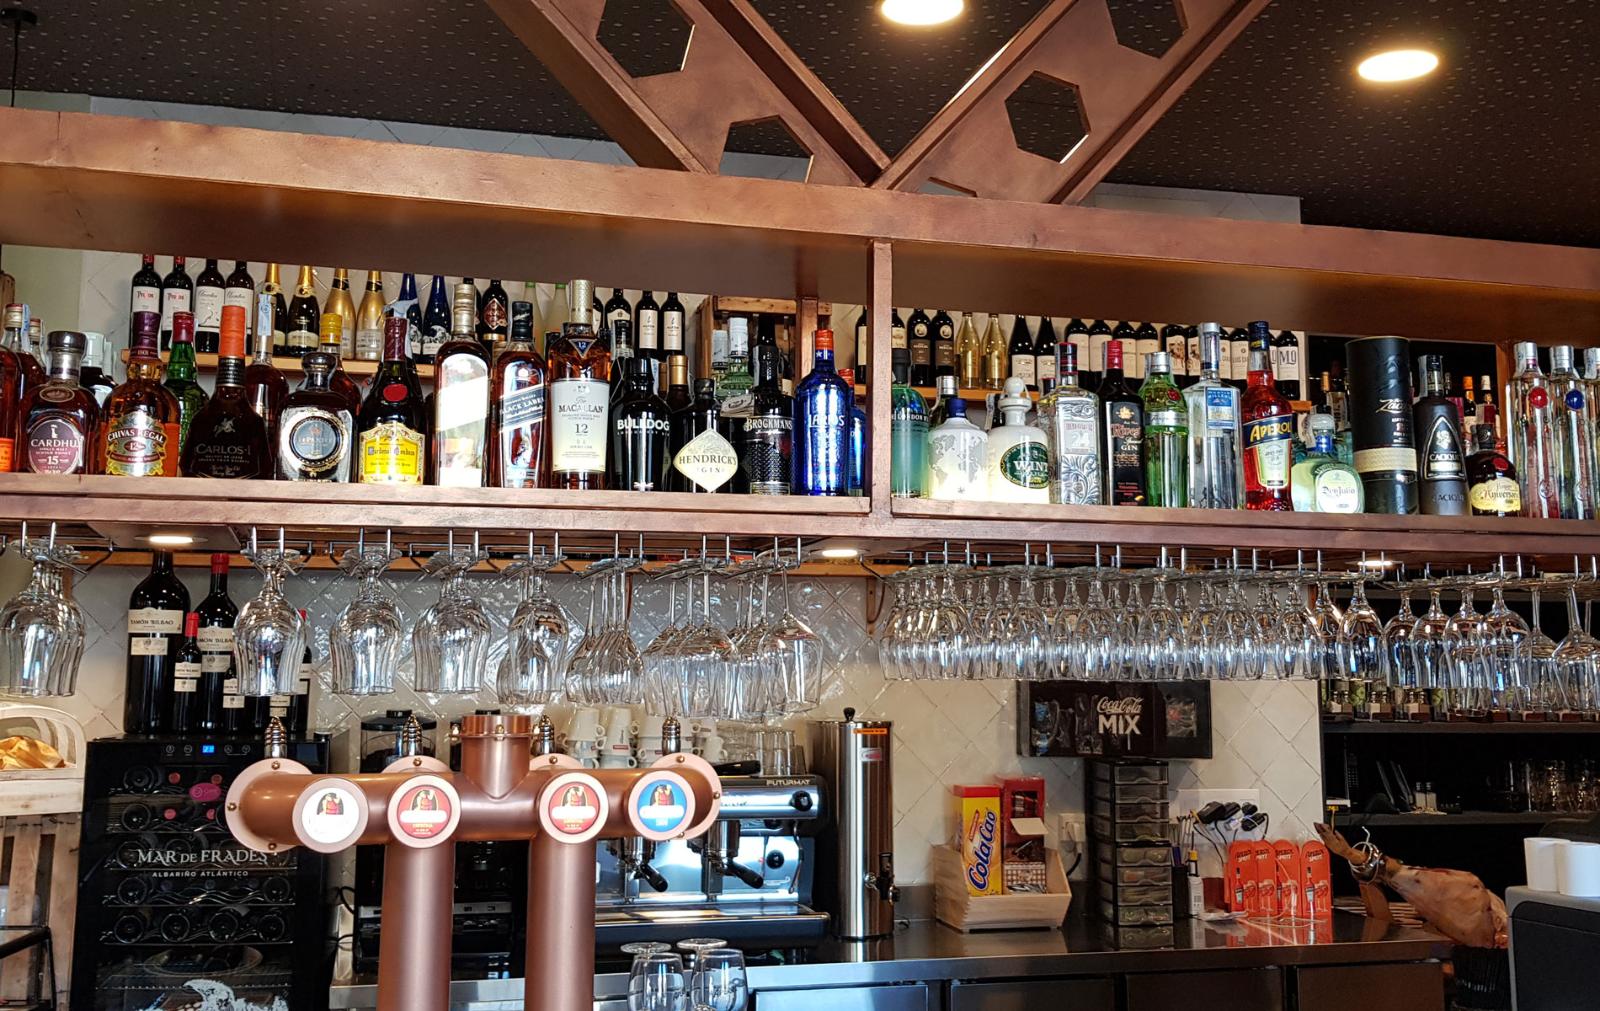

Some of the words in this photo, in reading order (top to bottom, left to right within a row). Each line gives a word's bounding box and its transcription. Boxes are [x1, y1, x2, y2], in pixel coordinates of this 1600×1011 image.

[558, 404, 604, 413] MACALLAN
[575, 423, 588, 434] 12
[617, 418, 670, 431] BULLDOG
[745, 416, 793, 431] BROCKMANS
[107, 429, 135, 442] CHIVAS
[137, 429, 164, 443] REGAL
[1250, 421, 1292, 442] APEROL
[31, 438, 79, 448] CARDHU
[47, 455, 59, 465] 15
[1096, 696, 1144, 714] Coca-Cola
[1098, 714, 1141, 735] MIX
[137, 849, 179, 867] MAR
[180, 853, 198, 864] DE
[201, 849, 269, 866] FRADES
[152, 870, 197, 878] ALBARIÑO
